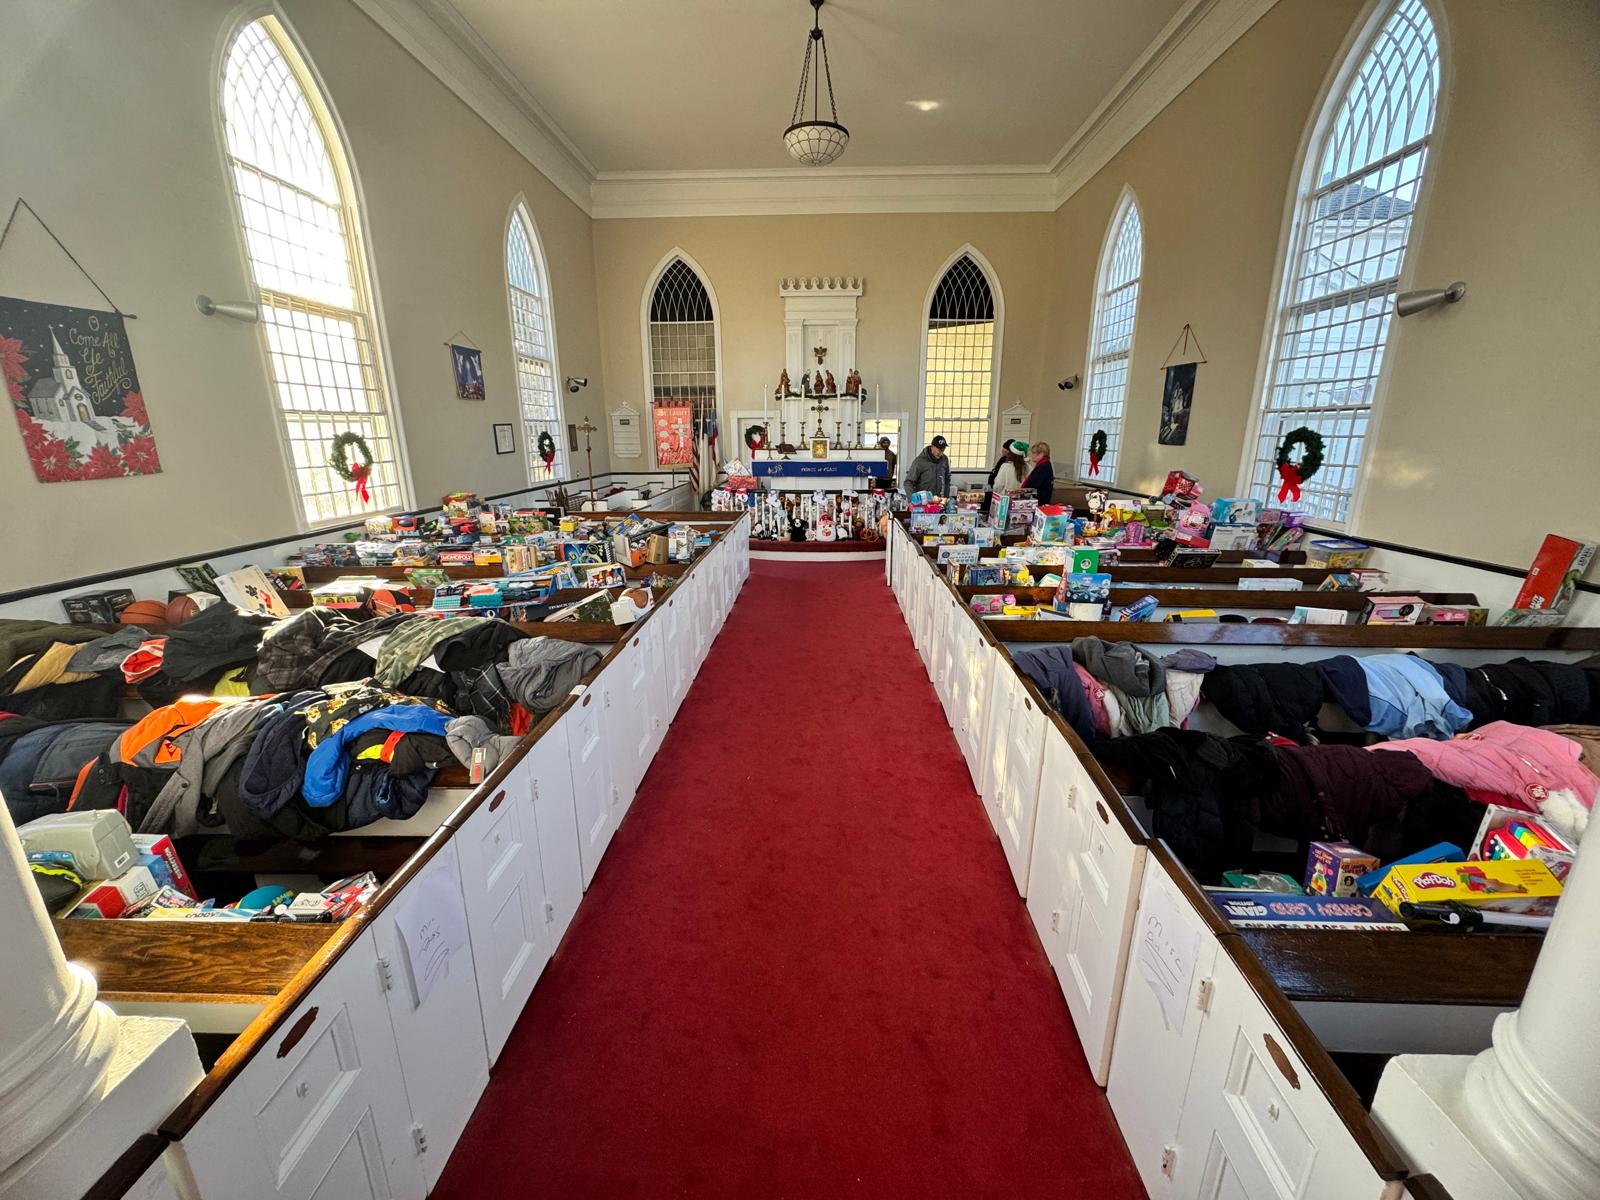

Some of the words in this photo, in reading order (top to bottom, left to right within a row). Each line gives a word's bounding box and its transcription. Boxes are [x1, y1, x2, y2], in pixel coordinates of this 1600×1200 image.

[88, 315, 99, 331] O
[69, 328, 100, 347] Come
[102, 331, 120, 358] All
[80, 347, 104, 376] Ye
[84, 357, 131, 404] Faithful
[1413, 872, 1456, 889] Play-Doh
[1223, 905, 1268, 917] GIANT
[1270, 902, 1315, 916] LAND
[1317, 902, 1373, 918] CANDY
